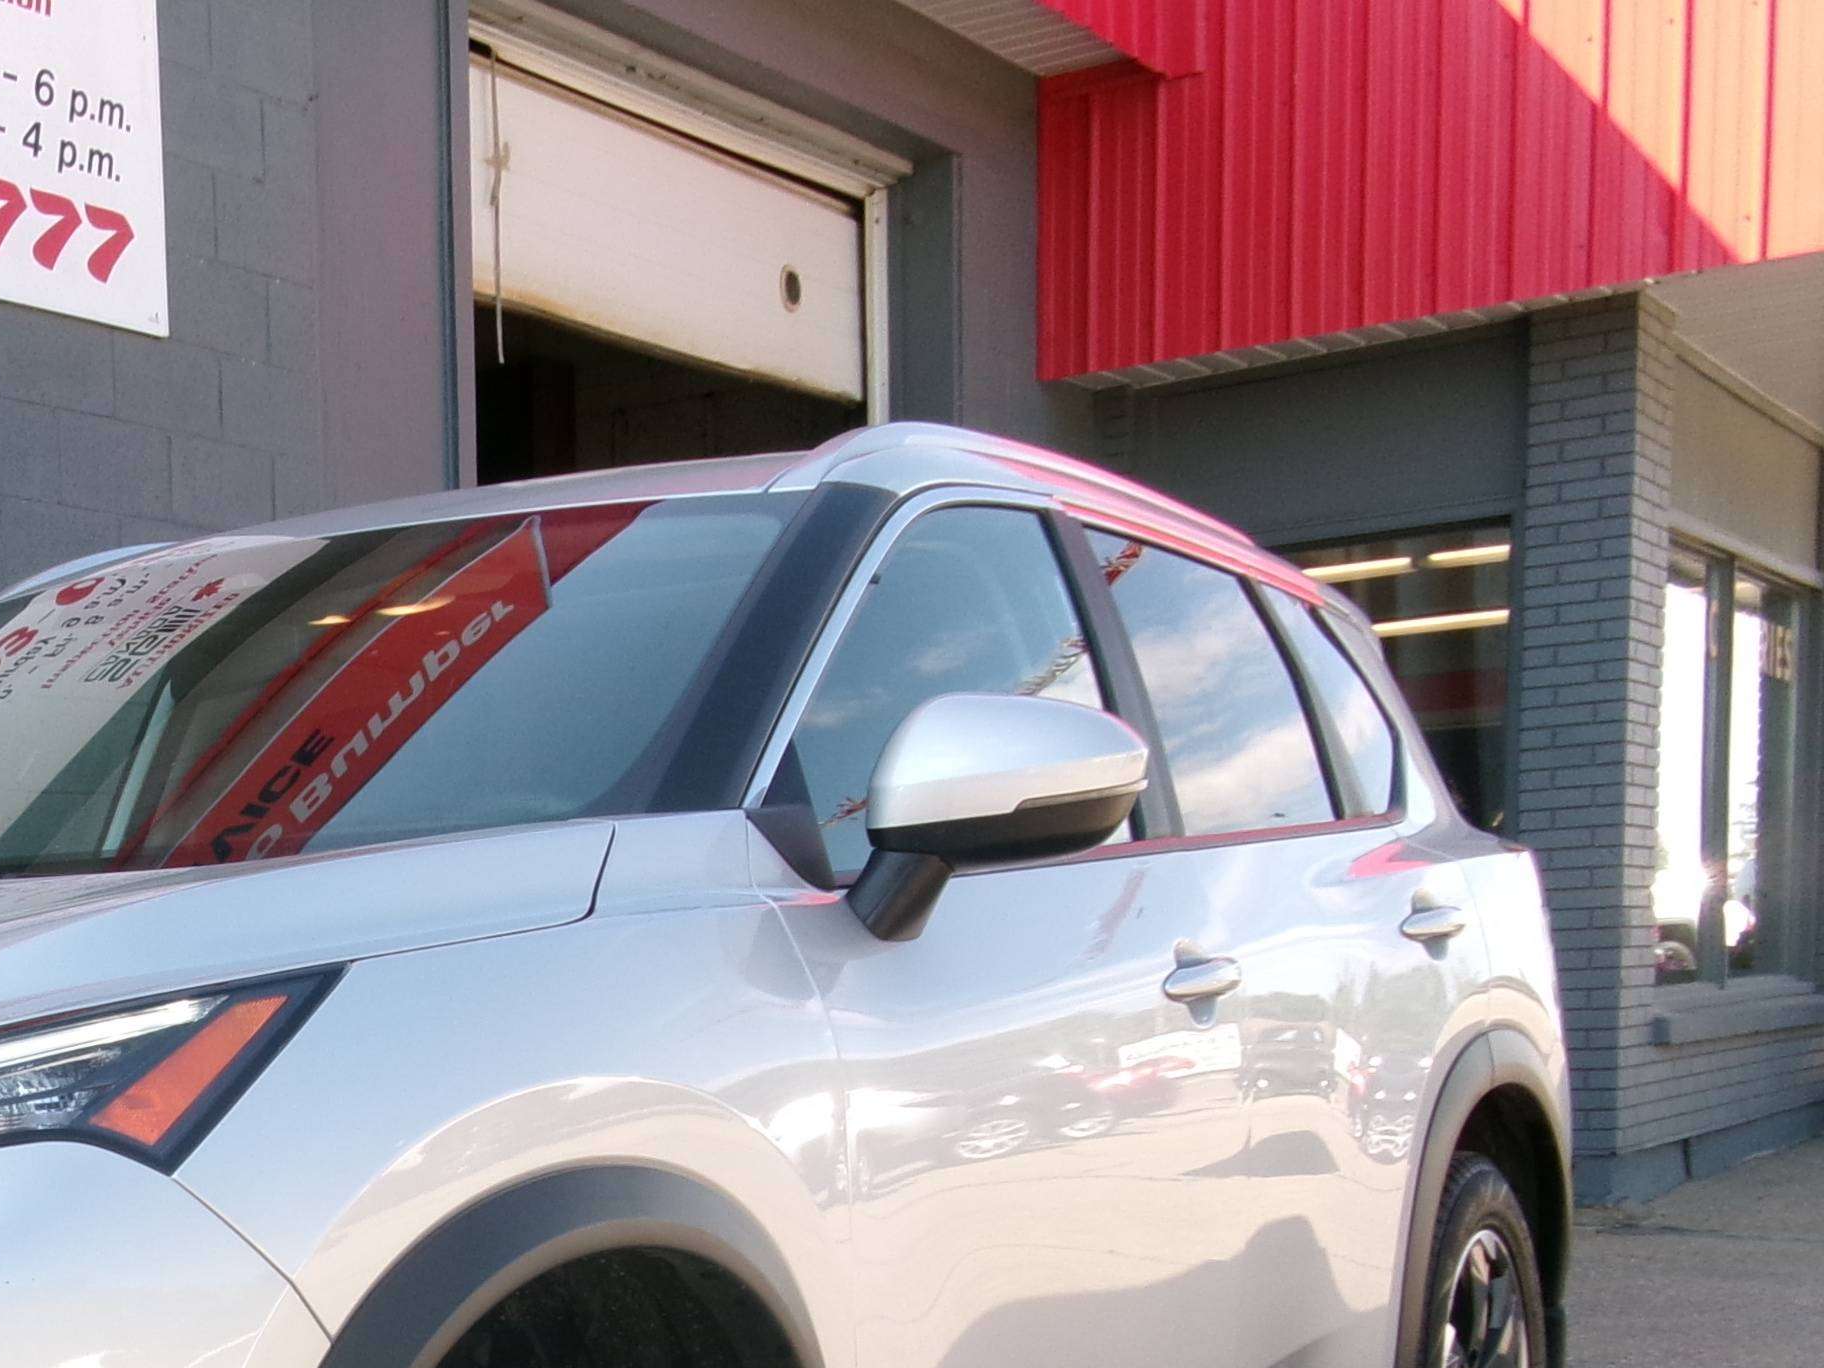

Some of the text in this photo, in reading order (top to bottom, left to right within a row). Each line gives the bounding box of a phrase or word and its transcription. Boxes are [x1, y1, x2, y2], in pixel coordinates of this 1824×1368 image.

[34, 68, 55, 107] 6
[68, 88, 131, 132] p.m.
[22, 122, 43, 157] 4
[58, 139, 121, 182] p.m.
